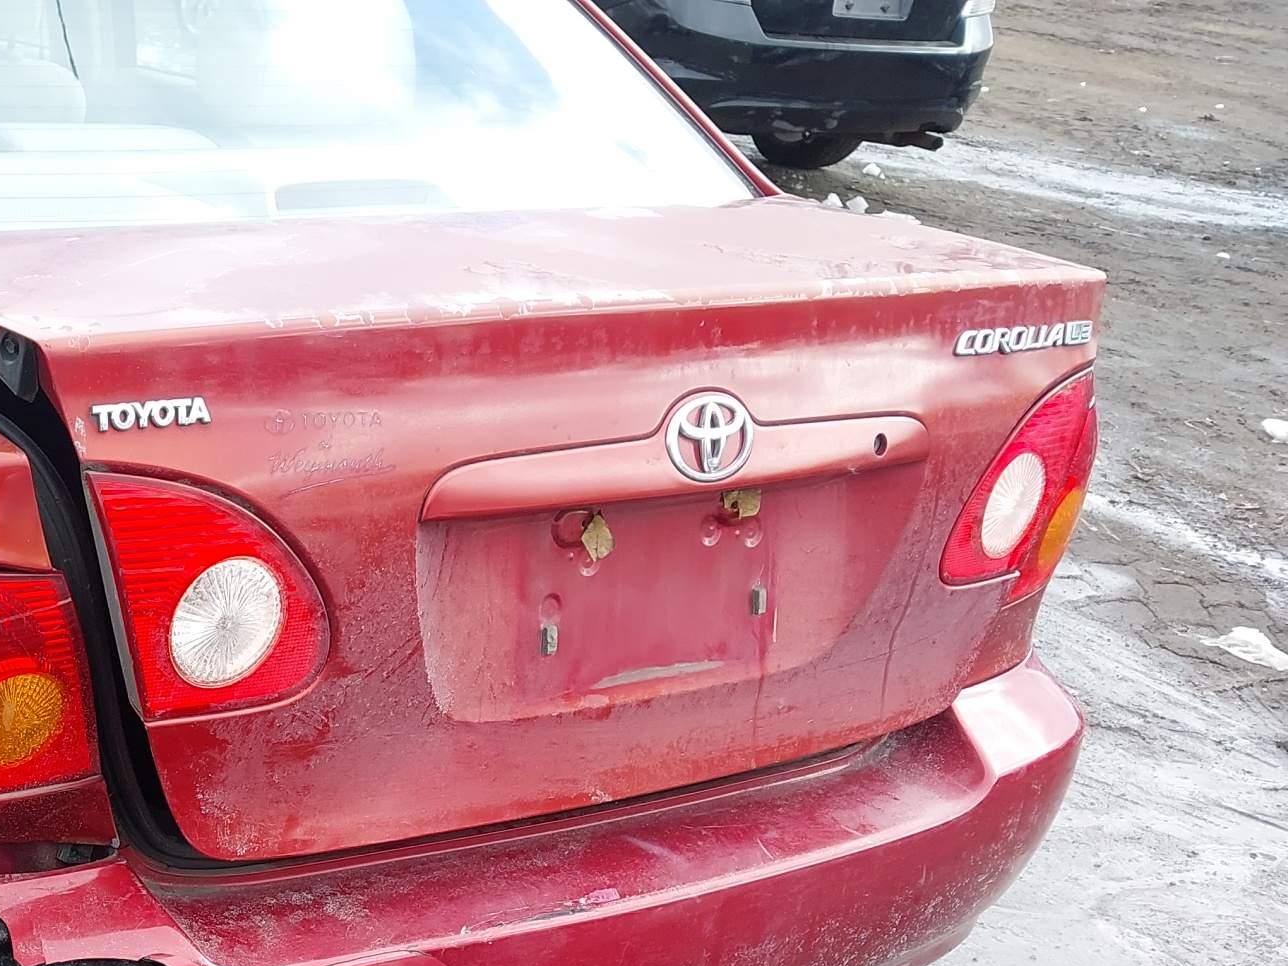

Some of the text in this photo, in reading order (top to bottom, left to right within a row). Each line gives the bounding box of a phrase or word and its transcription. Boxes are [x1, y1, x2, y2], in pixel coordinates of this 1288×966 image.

[954, 320, 1093, 357] COROLLA LE
[90, 396, 212, 432] TOYOTA
[302, 409, 383, 430] TOYOTA
